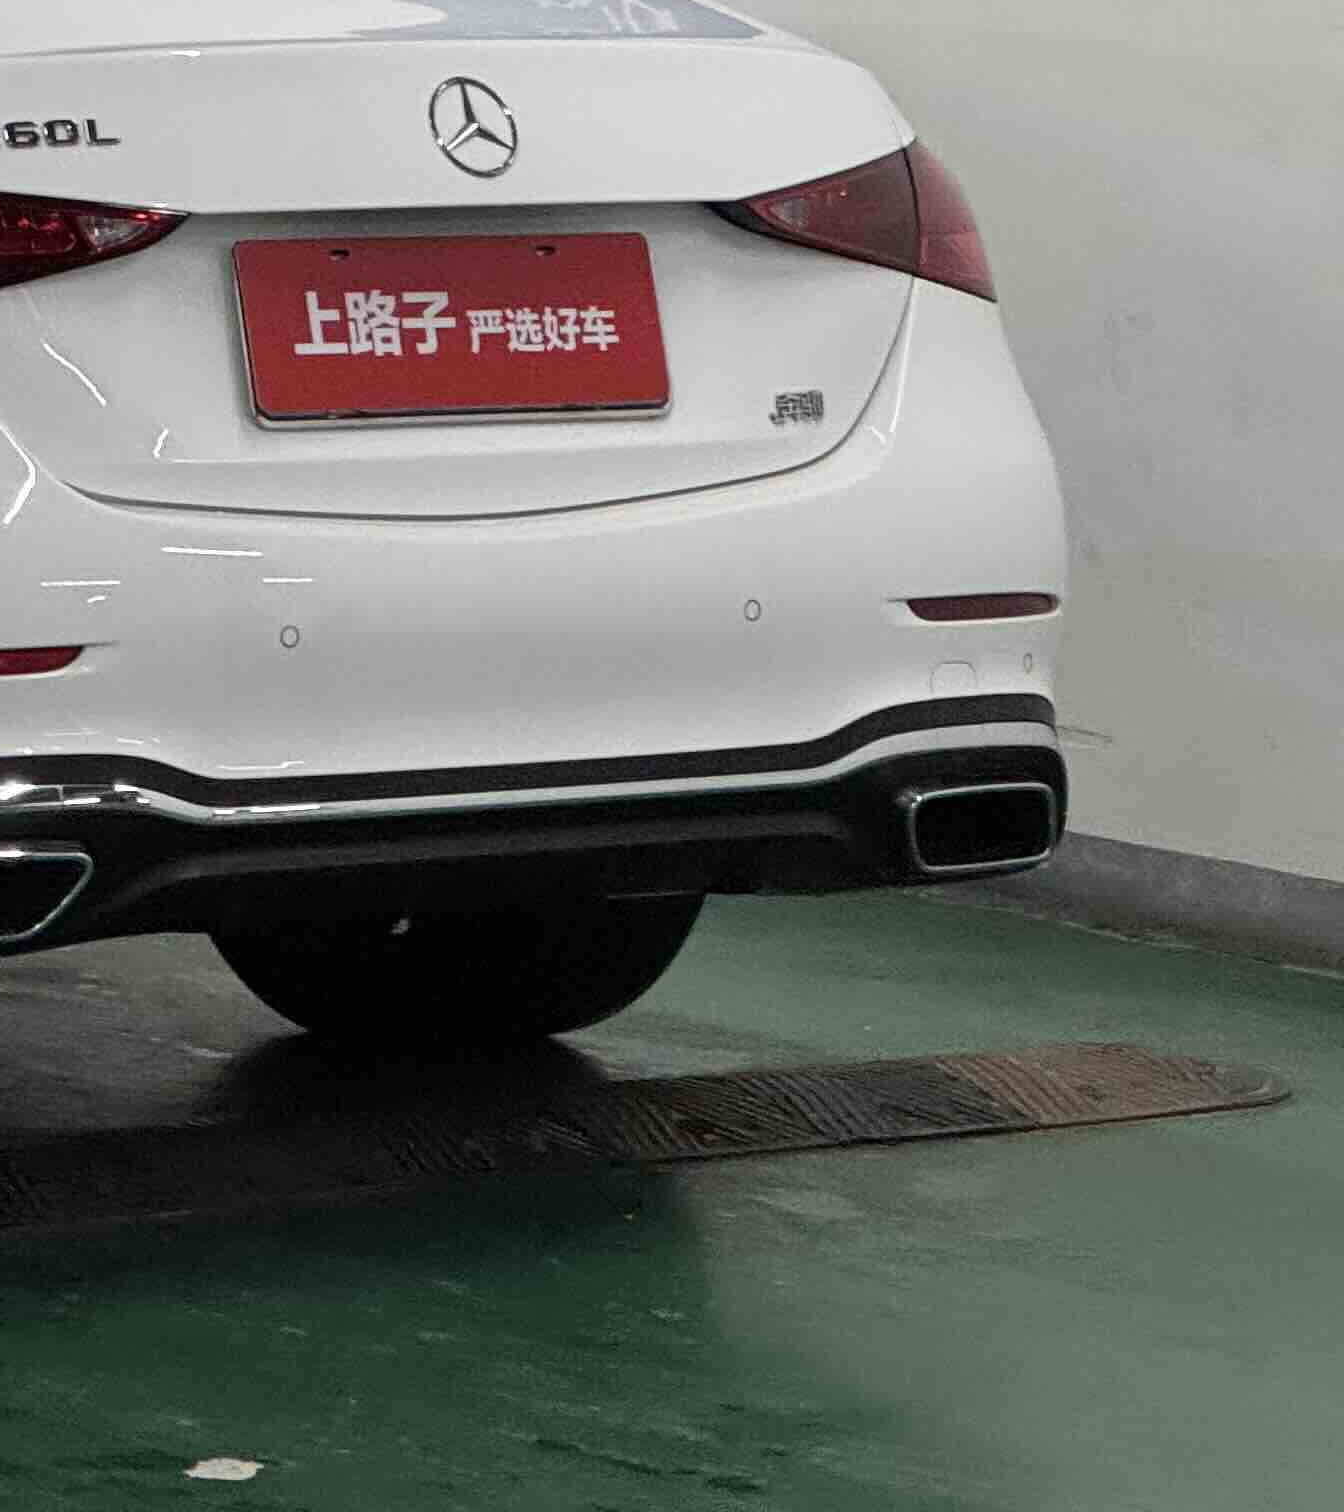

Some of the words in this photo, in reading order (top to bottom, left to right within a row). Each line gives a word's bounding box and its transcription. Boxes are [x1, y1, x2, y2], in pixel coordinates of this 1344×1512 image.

[294, 289, 457, 356] 上路子
[465, 306, 620, 354] 严选好车
